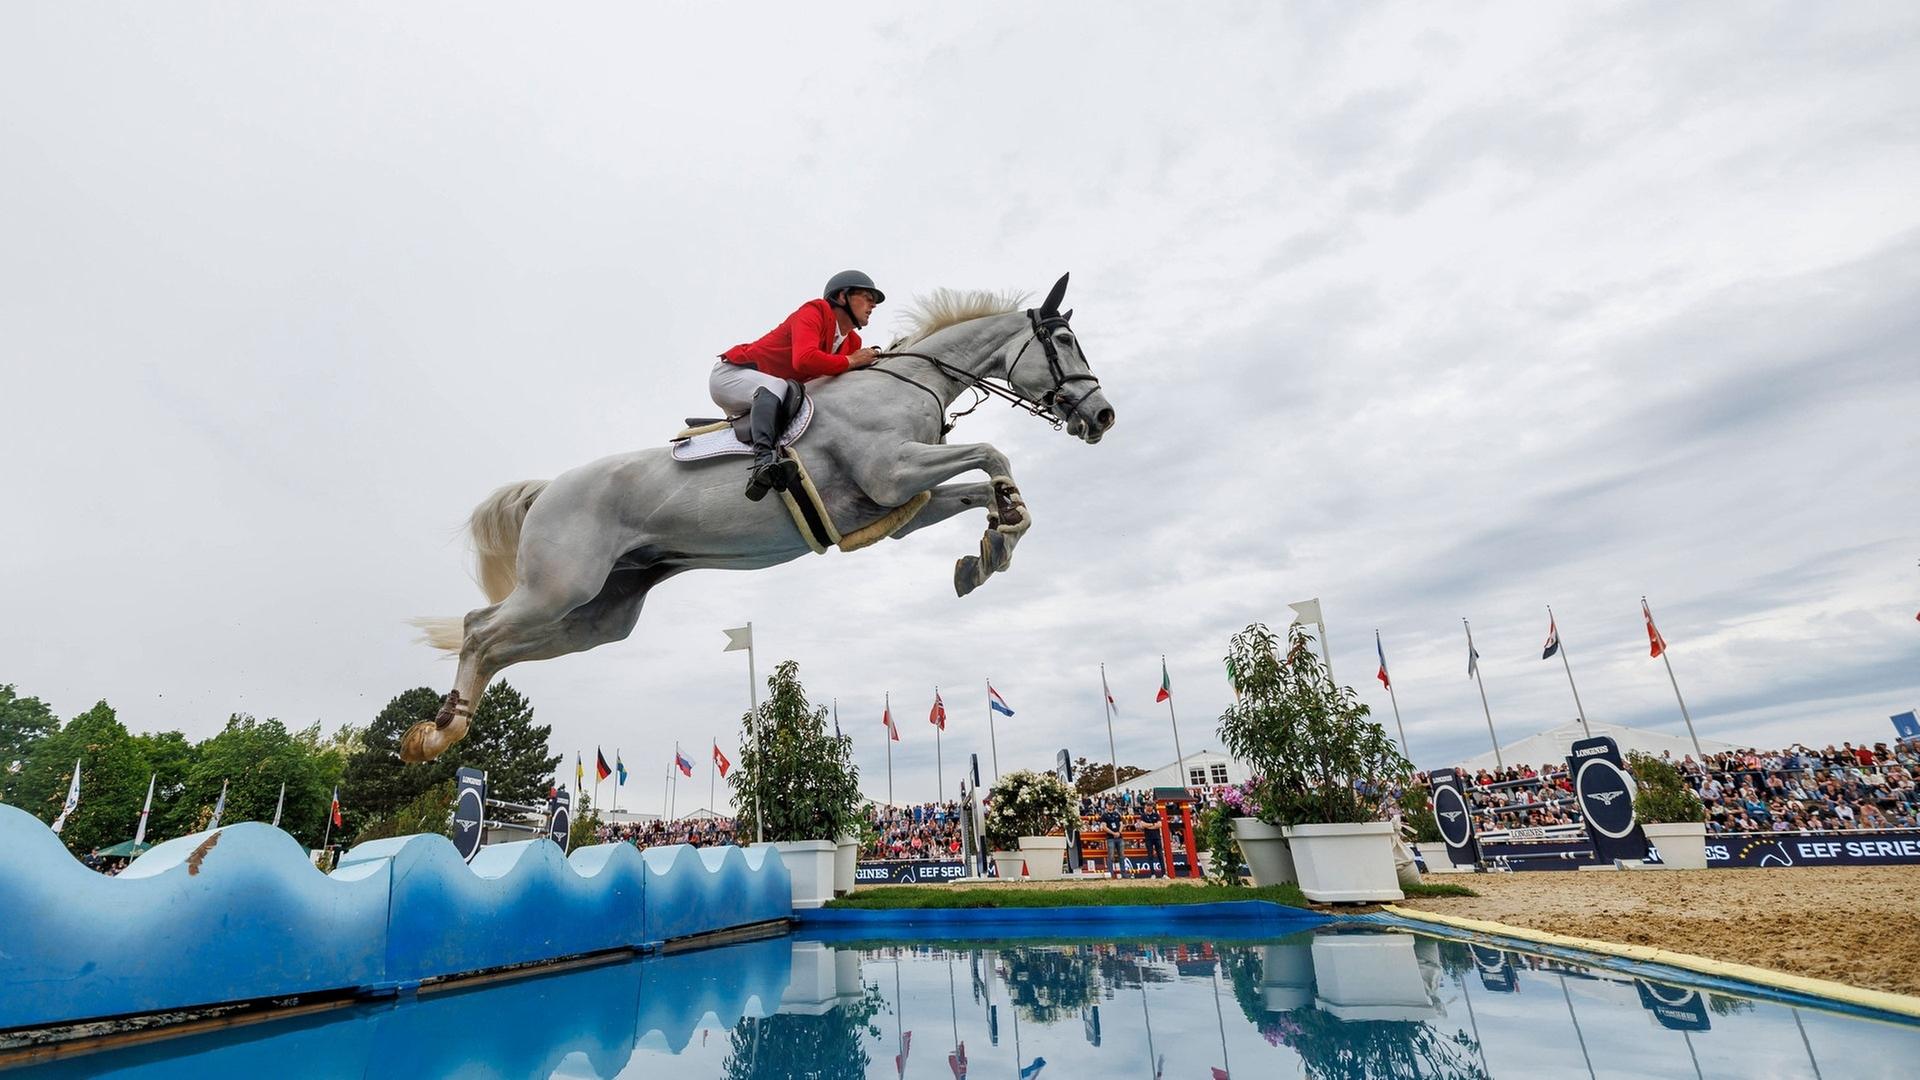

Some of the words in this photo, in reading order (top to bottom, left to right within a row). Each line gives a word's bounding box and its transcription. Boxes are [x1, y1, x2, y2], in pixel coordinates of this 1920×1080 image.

[1575, 745, 1609, 757] LONGINES
[1511, 828, 1544, 838] LONGINES
[1797, 843, 1842, 858] EEF
[856, 868, 889, 879] GINES
[920, 867, 939, 877] EEF
[941, 866, 965, 877] SERI
